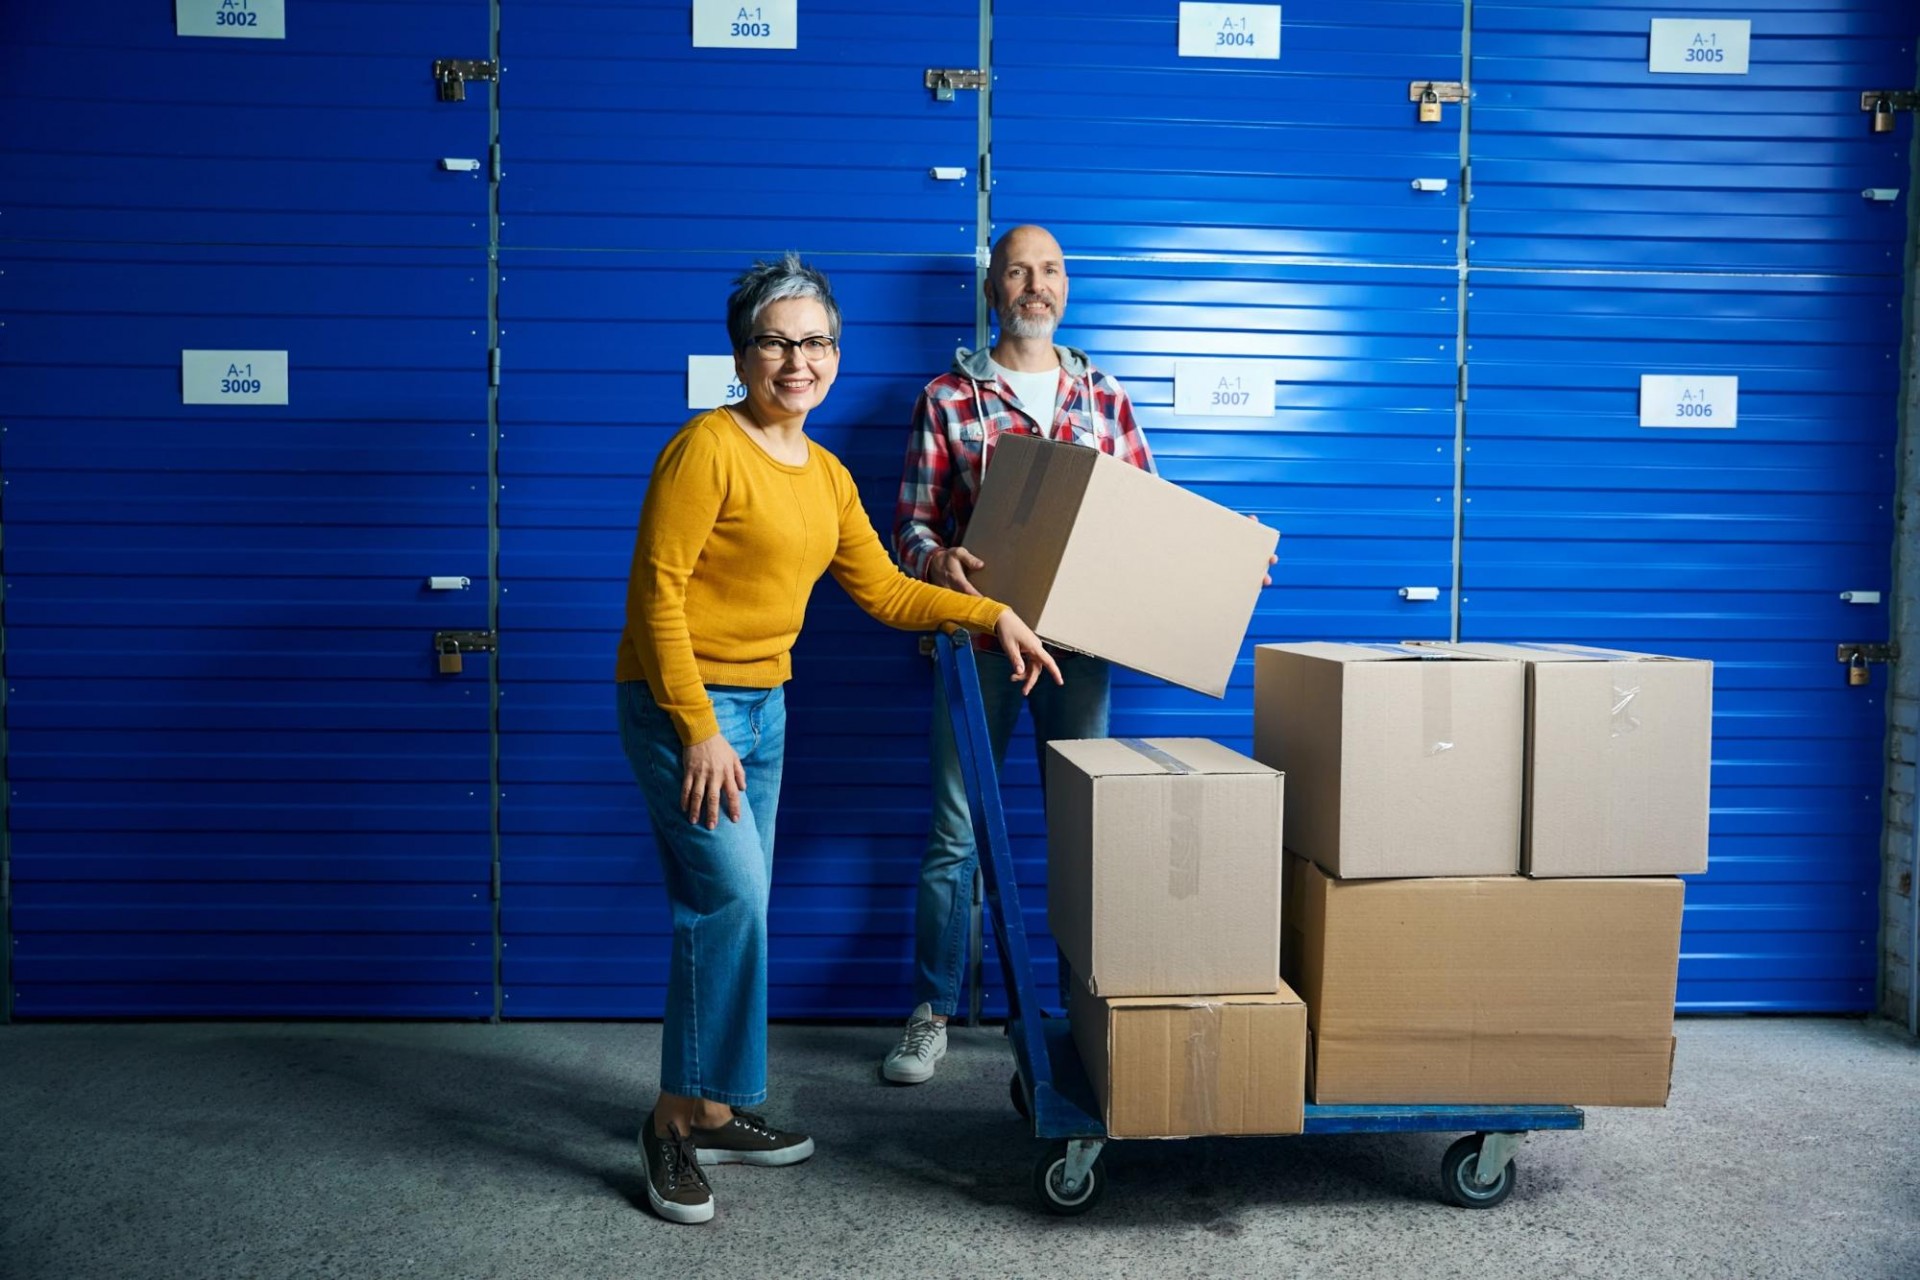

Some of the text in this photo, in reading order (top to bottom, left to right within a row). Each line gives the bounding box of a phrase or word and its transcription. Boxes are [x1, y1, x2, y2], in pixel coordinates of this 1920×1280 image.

[222, 0, 247, 9] A-1
[216, 11, 257, 26] 3002
[737, 7, 761, 20] A-1
[731, 23, 770, 36] 3003
[1222, 17, 1246, 30] A-1
[1216, 32, 1254, 46] 3004
[1693, 33, 1716, 46] A-1
[1685, 48, 1723, 62] 3005
[227, 364, 252, 376] A-1
[221, 379, 261, 393] 3009
[1218, 376, 1241, 389] A-1
[726, 384, 746, 398] 30
[1682, 389, 1704, 402] A-1
[1211, 391, 1250, 405] 3007
[1675, 404, 1712, 417] 3006
